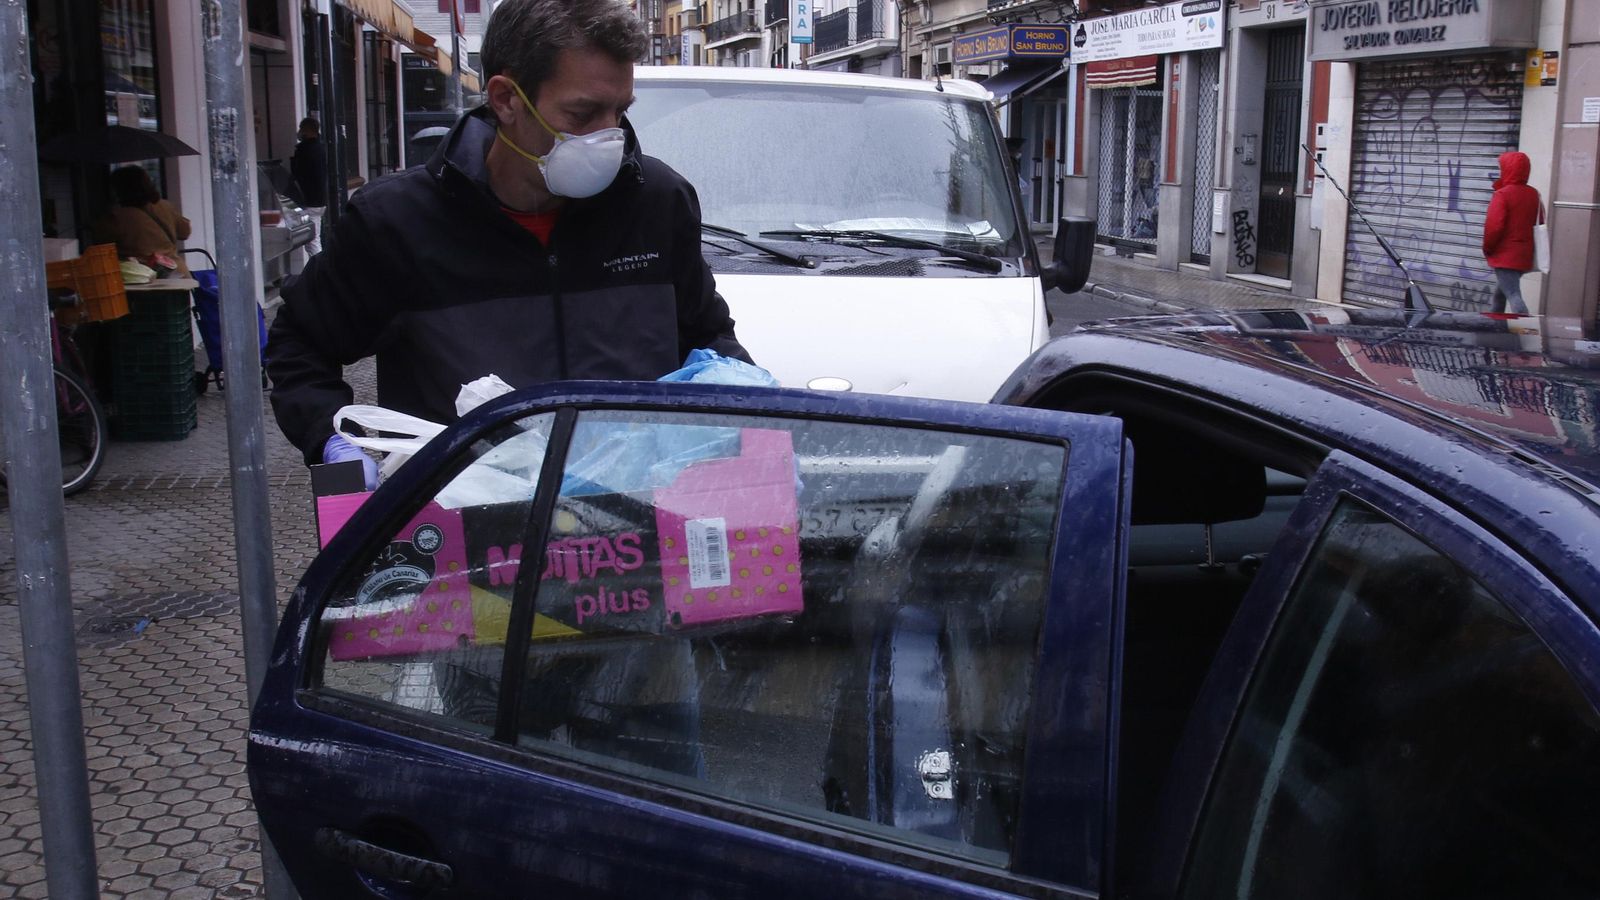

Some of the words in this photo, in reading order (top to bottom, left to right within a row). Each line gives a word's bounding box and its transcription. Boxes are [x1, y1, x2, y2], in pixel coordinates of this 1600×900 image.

[1091, 18, 1109, 35] JOSE
[1111, 13, 1139, 31] MARIA
[1140, 7, 1176, 26] GARCIA
[1266, 4, 1275, 19] 91
[1321, 2, 1381, 31] JOYERIA
[957, 41, 974, 57] HORNO
[975, 38, 987, 54] SAN
[987, 35, 1007, 52] BRUNO
[1016, 42, 1032, 50] SAN
[1035, 42, 1064, 50] BRUNO
[1026, 31, 1055, 40] HORNO
[1344, 31, 1390, 50] SALVADOR
[1394, 25, 1446, 45] GONZALEZ
[603, 252, 659, 267] MOUNTAIN
[612, 261, 648, 272] LEGEND
[487, 532, 644, 586] MTITAS
[575, 585, 651, 625] plus
